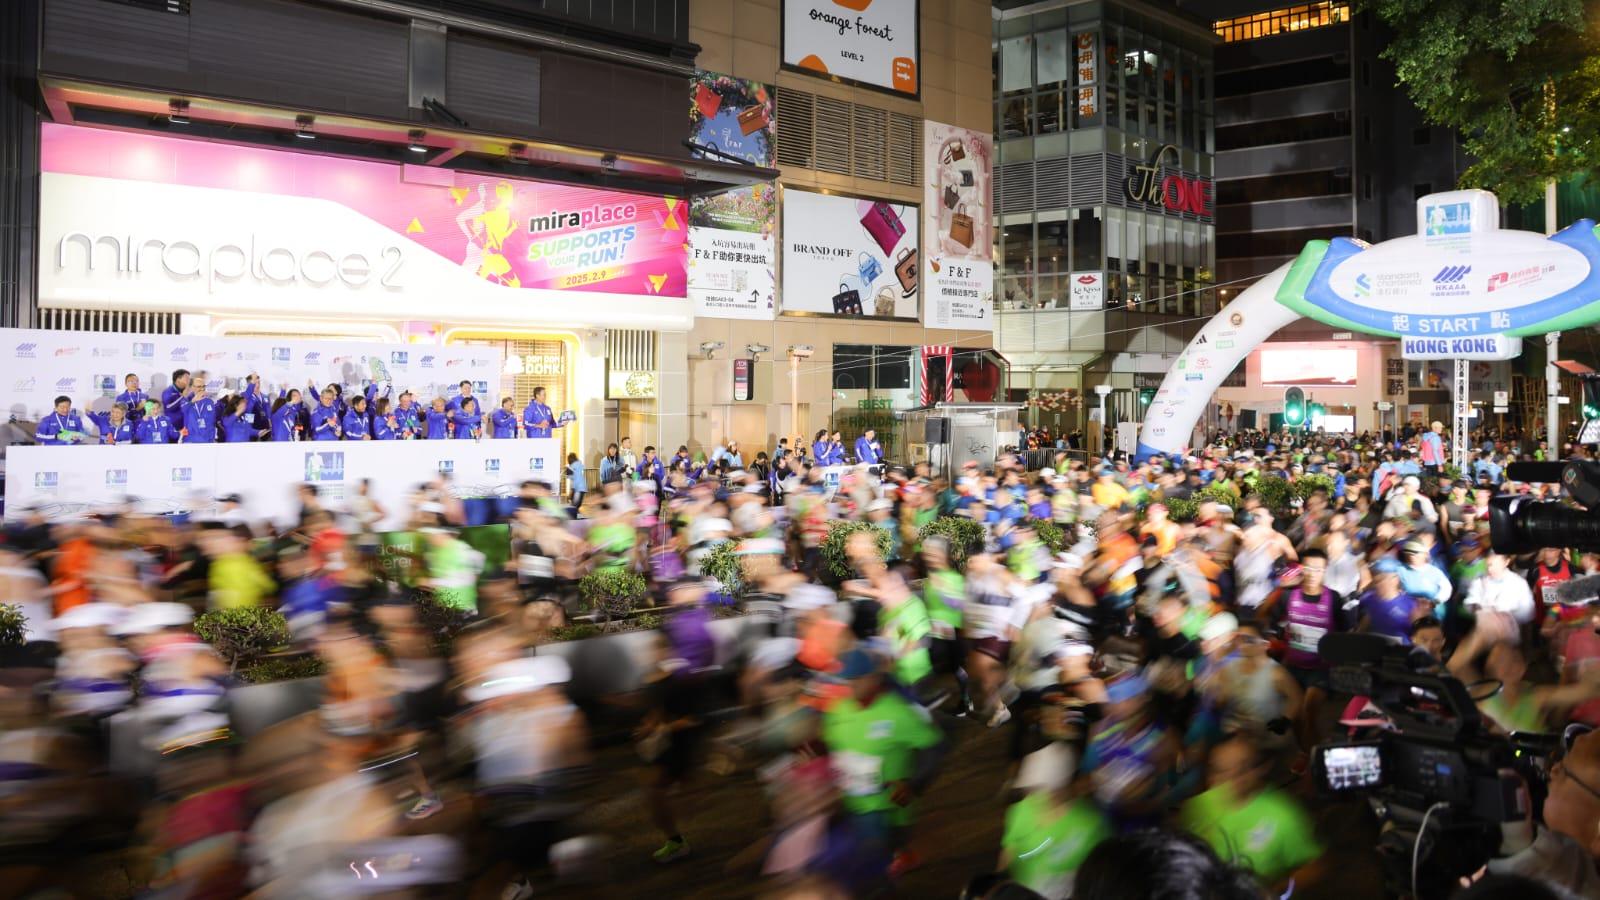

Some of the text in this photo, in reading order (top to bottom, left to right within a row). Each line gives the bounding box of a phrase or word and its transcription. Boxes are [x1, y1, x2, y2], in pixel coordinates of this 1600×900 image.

[808, 8, 894, 41] orange forest
[841, 50, 859, 61] LEVEL
[1128, 144, 1213, 216] The ONE
[528, 203, 636, 233] miraplace
[527, 225, 636, 261] SUPPORTS
[695, 248, 702, 259] F
[703, 249, 711, 260] &
[793, 243, 853, 258] BRAND OFF
[57, 231, 406, 295] miraplace 2
[548, 243, 626, 269] YOUR RUN!
[566, 270, 607, 286] 2025.2.9
[949, 265, 972, 279] F & F
[1392, 311, 1511, 333] 起 START 點
[1405, 339, 1497, 355] HONG KONG
